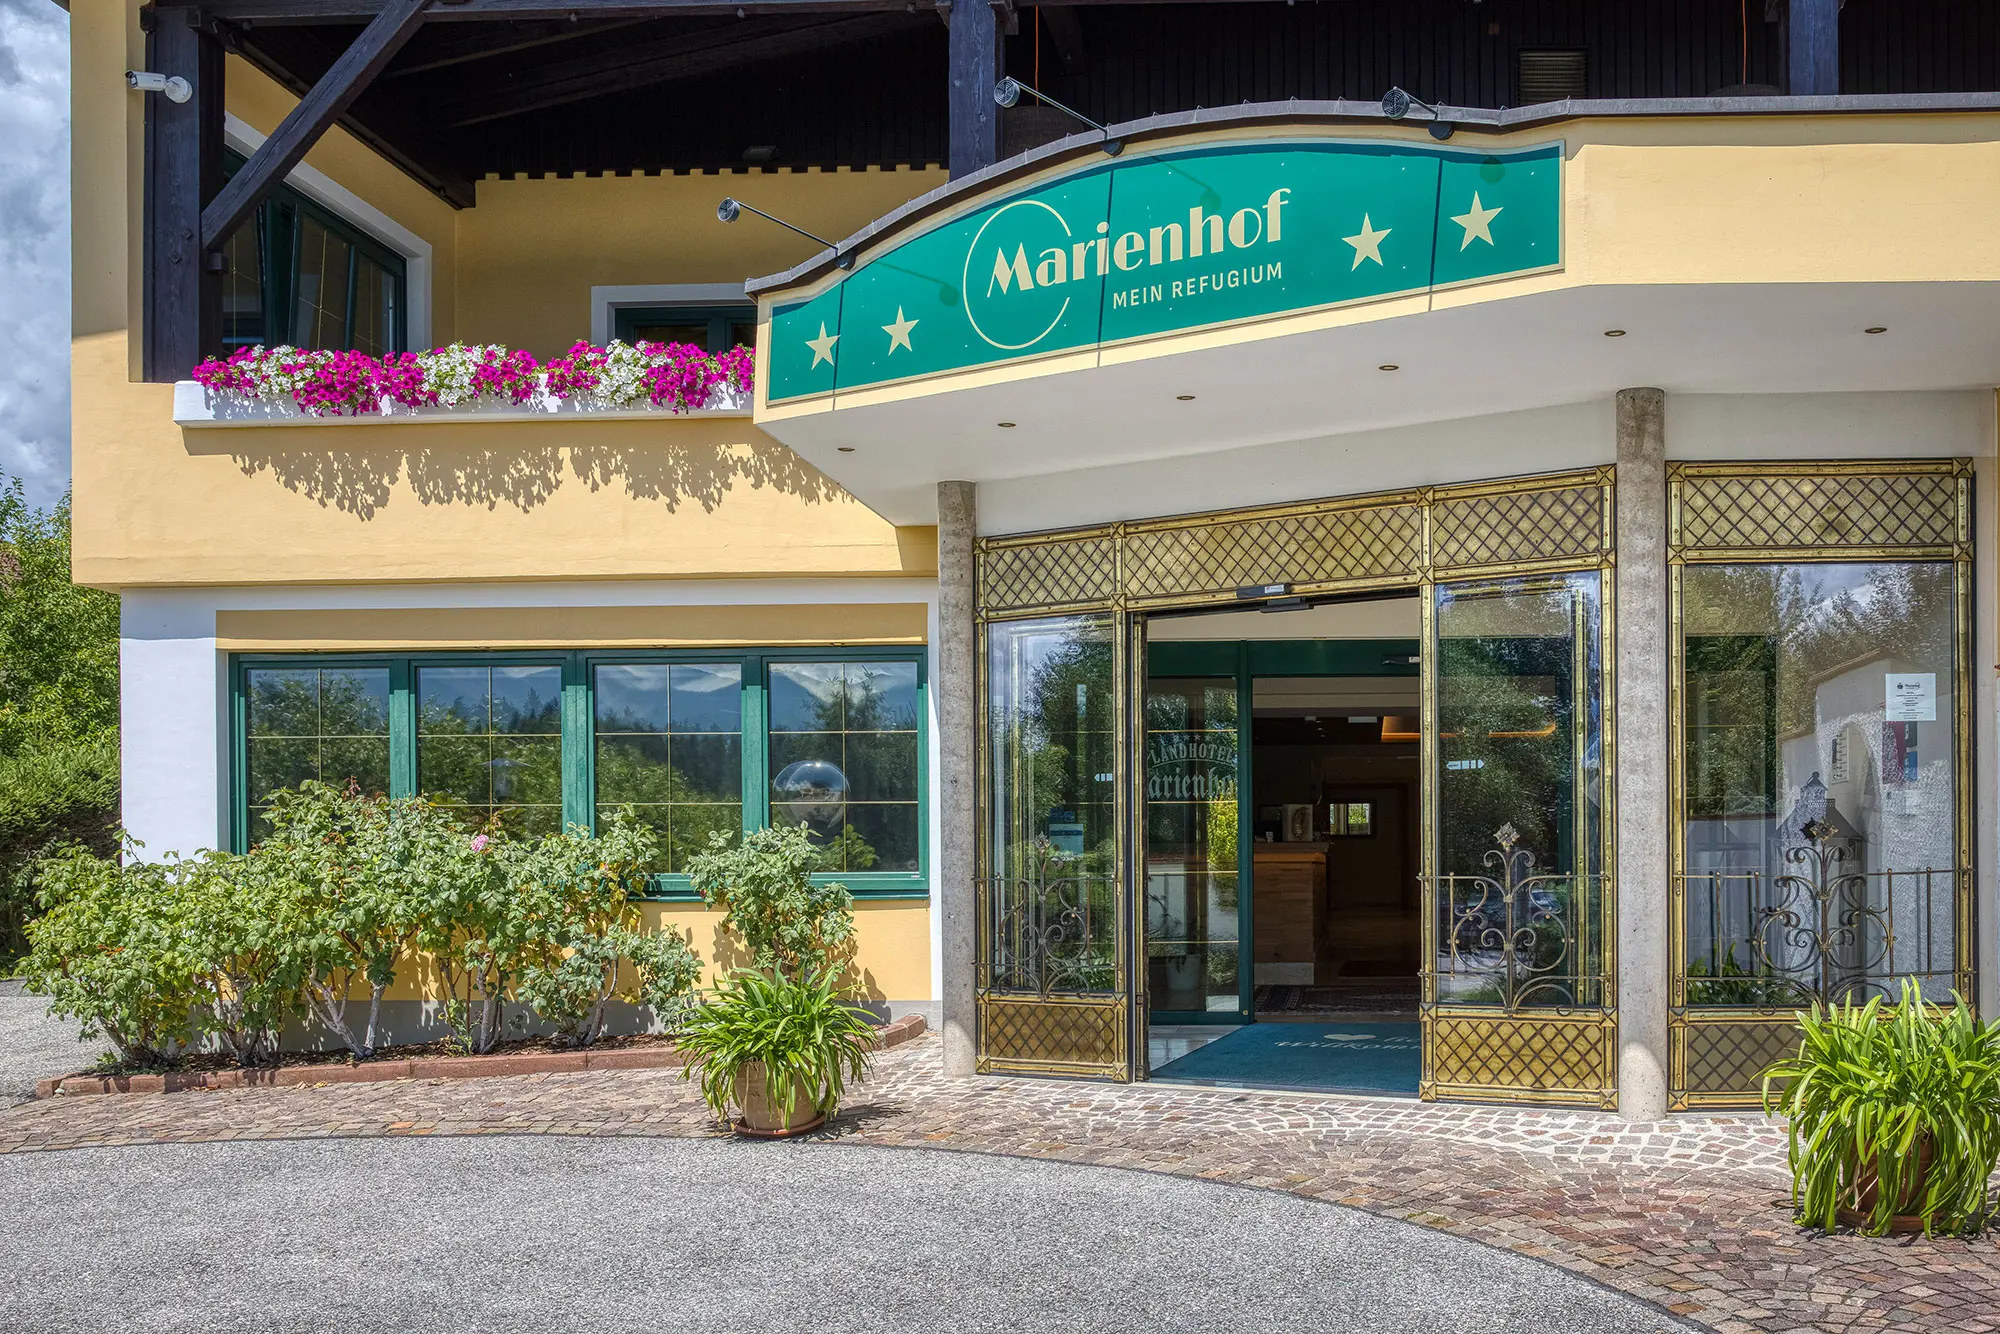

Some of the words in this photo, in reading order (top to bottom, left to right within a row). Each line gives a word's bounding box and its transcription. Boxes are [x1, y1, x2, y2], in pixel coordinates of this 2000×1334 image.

[987, 188, 1291, 298] Marienhof
[1113, 284, 1162, 309] MEIN
[1172, 262, 1283, 299] REFUGIUM
[1149, 742, 1236, 765] LANDHOTEL
[1148, 766, 1236, 799] arienho
